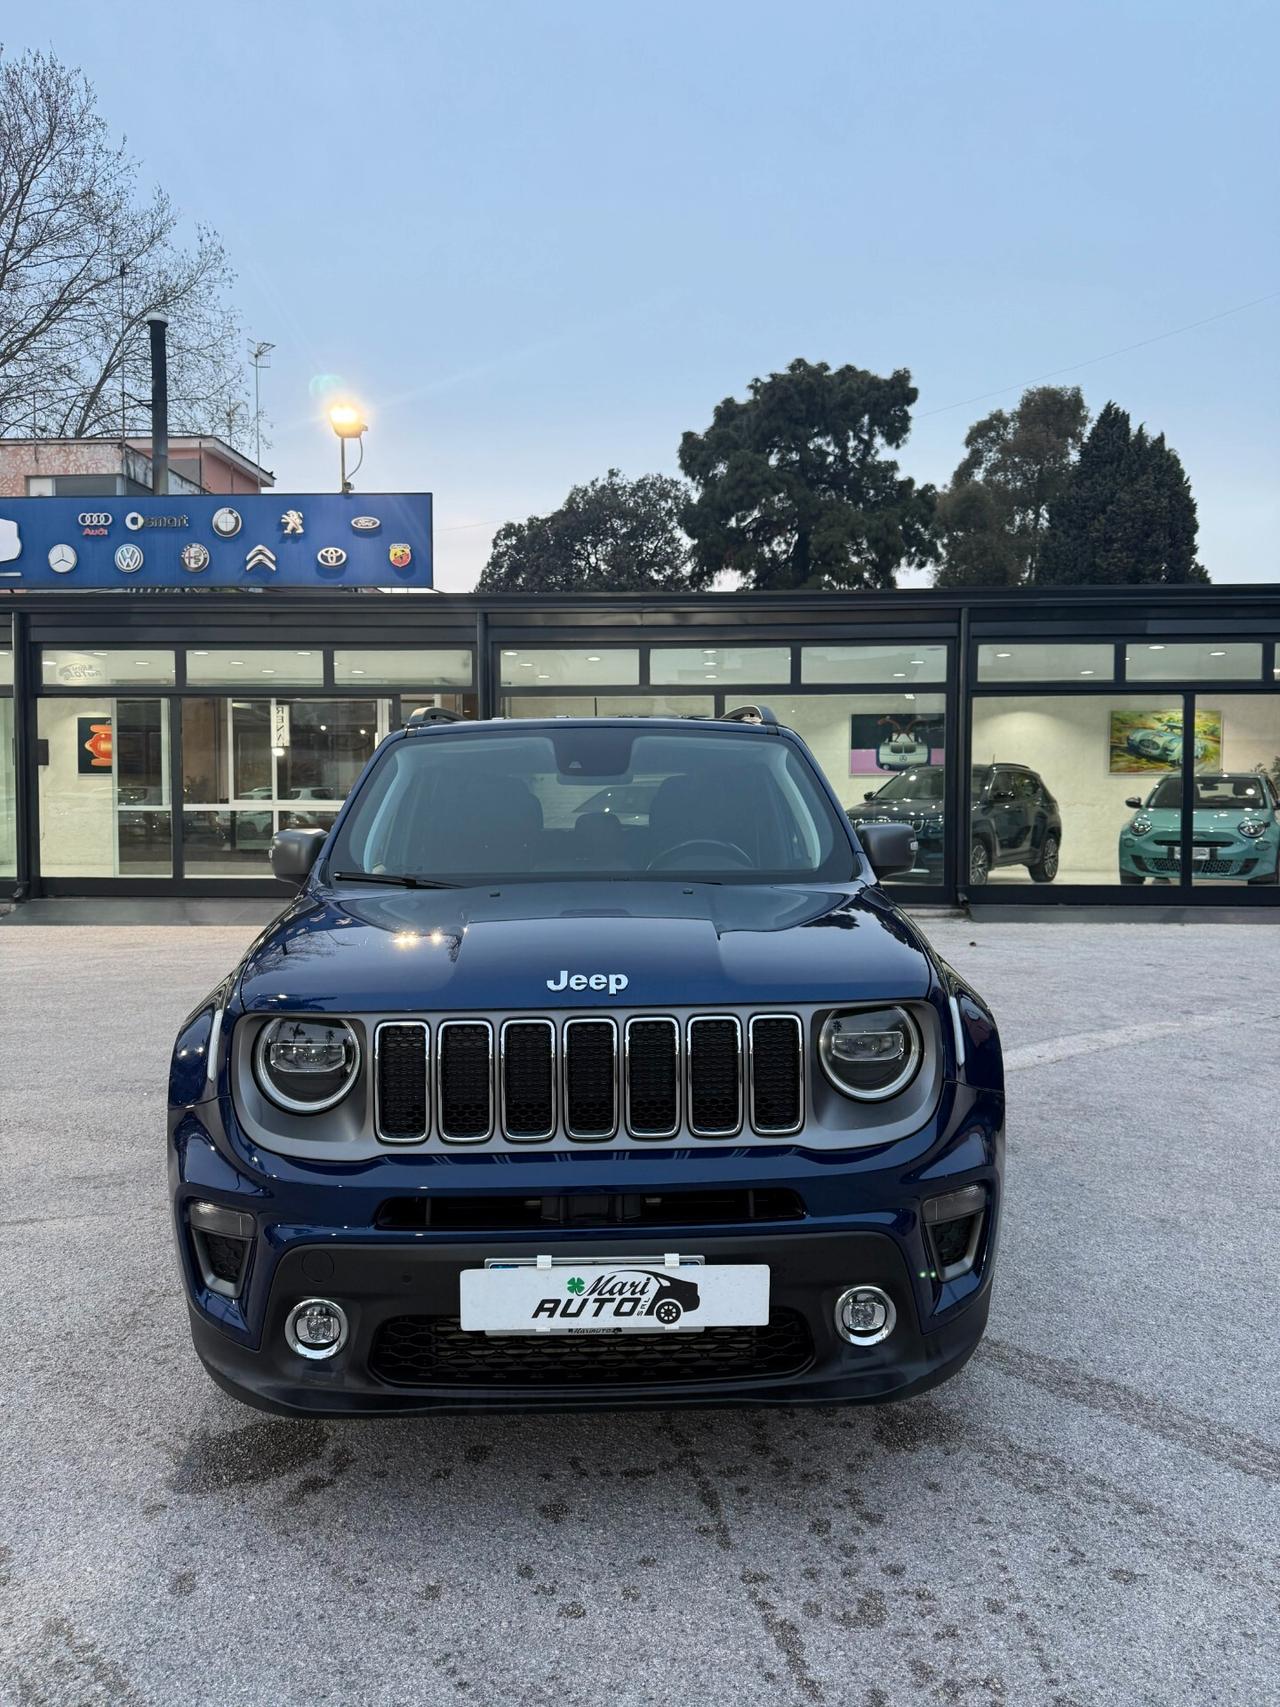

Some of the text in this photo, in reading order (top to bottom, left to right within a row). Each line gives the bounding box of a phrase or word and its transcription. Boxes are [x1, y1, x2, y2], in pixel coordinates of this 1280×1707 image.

[83, 528, 108, 536] Audi
[546, 970, 629, 995] Jeep
[578, 1275, 650, 1296] Mari
[531, 1298, 642, 1318] AUTO
